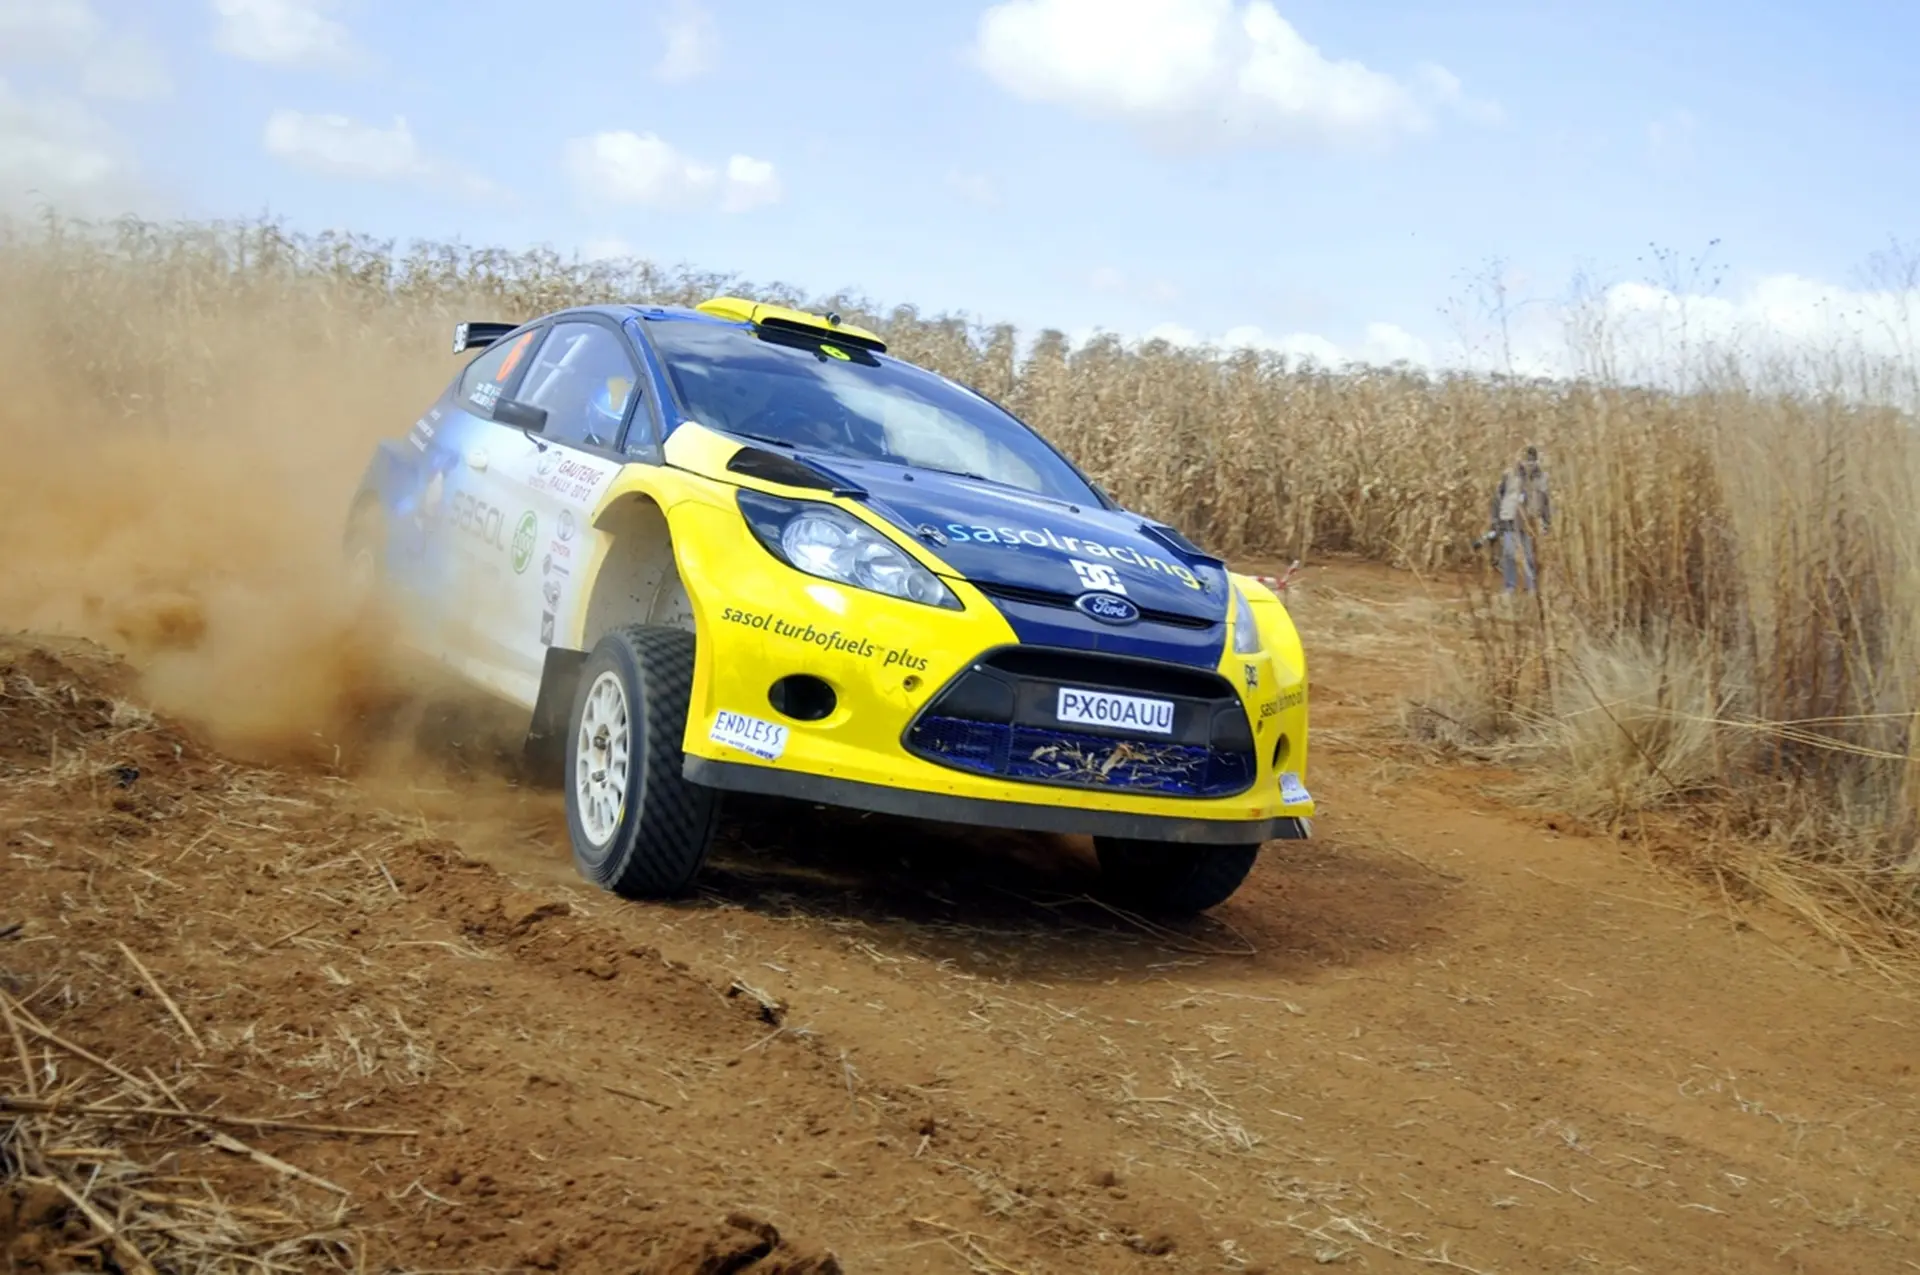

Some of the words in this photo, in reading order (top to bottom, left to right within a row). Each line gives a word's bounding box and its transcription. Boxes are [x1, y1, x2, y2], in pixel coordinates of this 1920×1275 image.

[549, 475, 572, 493] RALLY
[559, 459, 604, 486] GAUTENG
[1069, 558, 1128, 596] DC
[1092, 597, 1128, 618] Ford
[721, 607, 773, 631] sasol
[776, 618, 875, 658] turbofuels
[883, 648, 929, 672] plus
[1063, 693, 1171, 728] PX60AUU
[714, 711, 783, 746] ENDLESS
